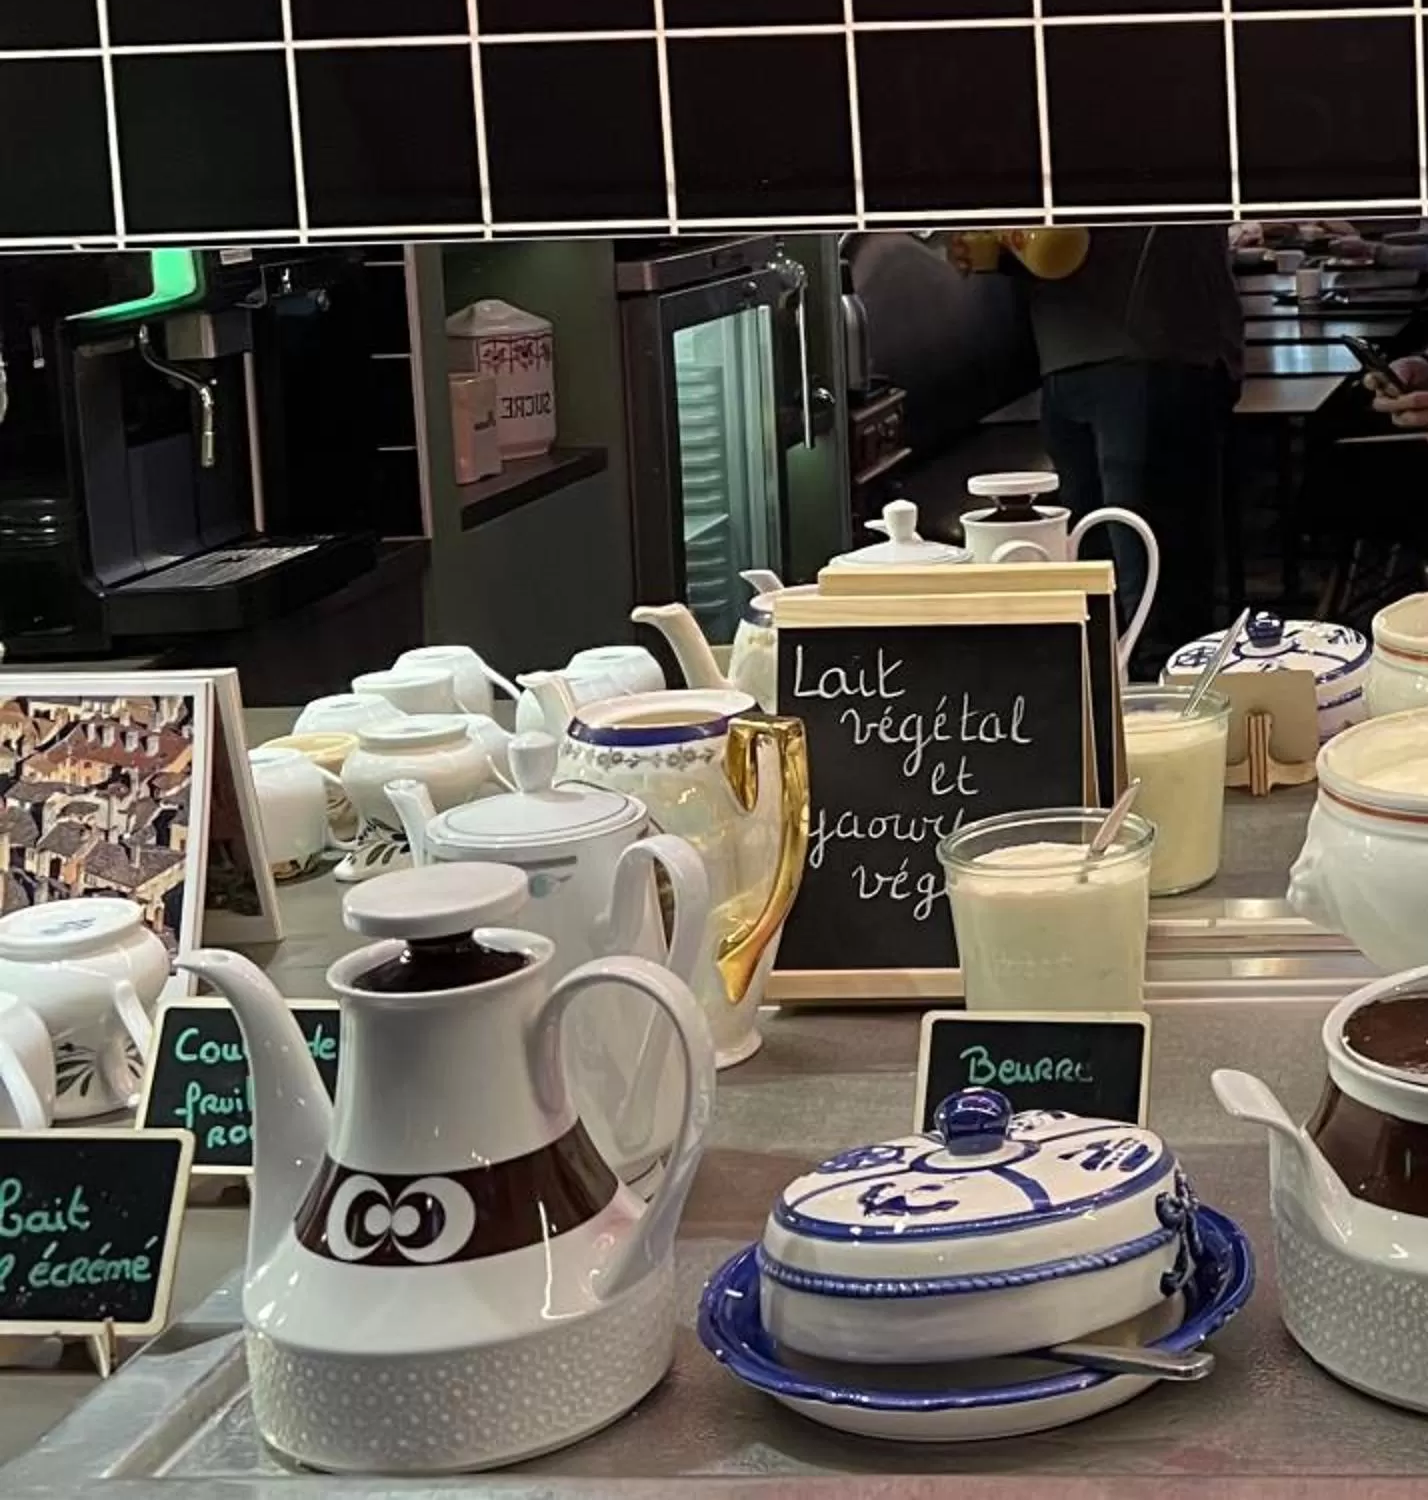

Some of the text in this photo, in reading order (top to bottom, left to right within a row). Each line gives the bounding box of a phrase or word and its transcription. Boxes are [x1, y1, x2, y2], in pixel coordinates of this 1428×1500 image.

[793, 644, 906, 699] Lait
[840, 692, 1033, 777] végétal
[931, 755, 980, 795] et
